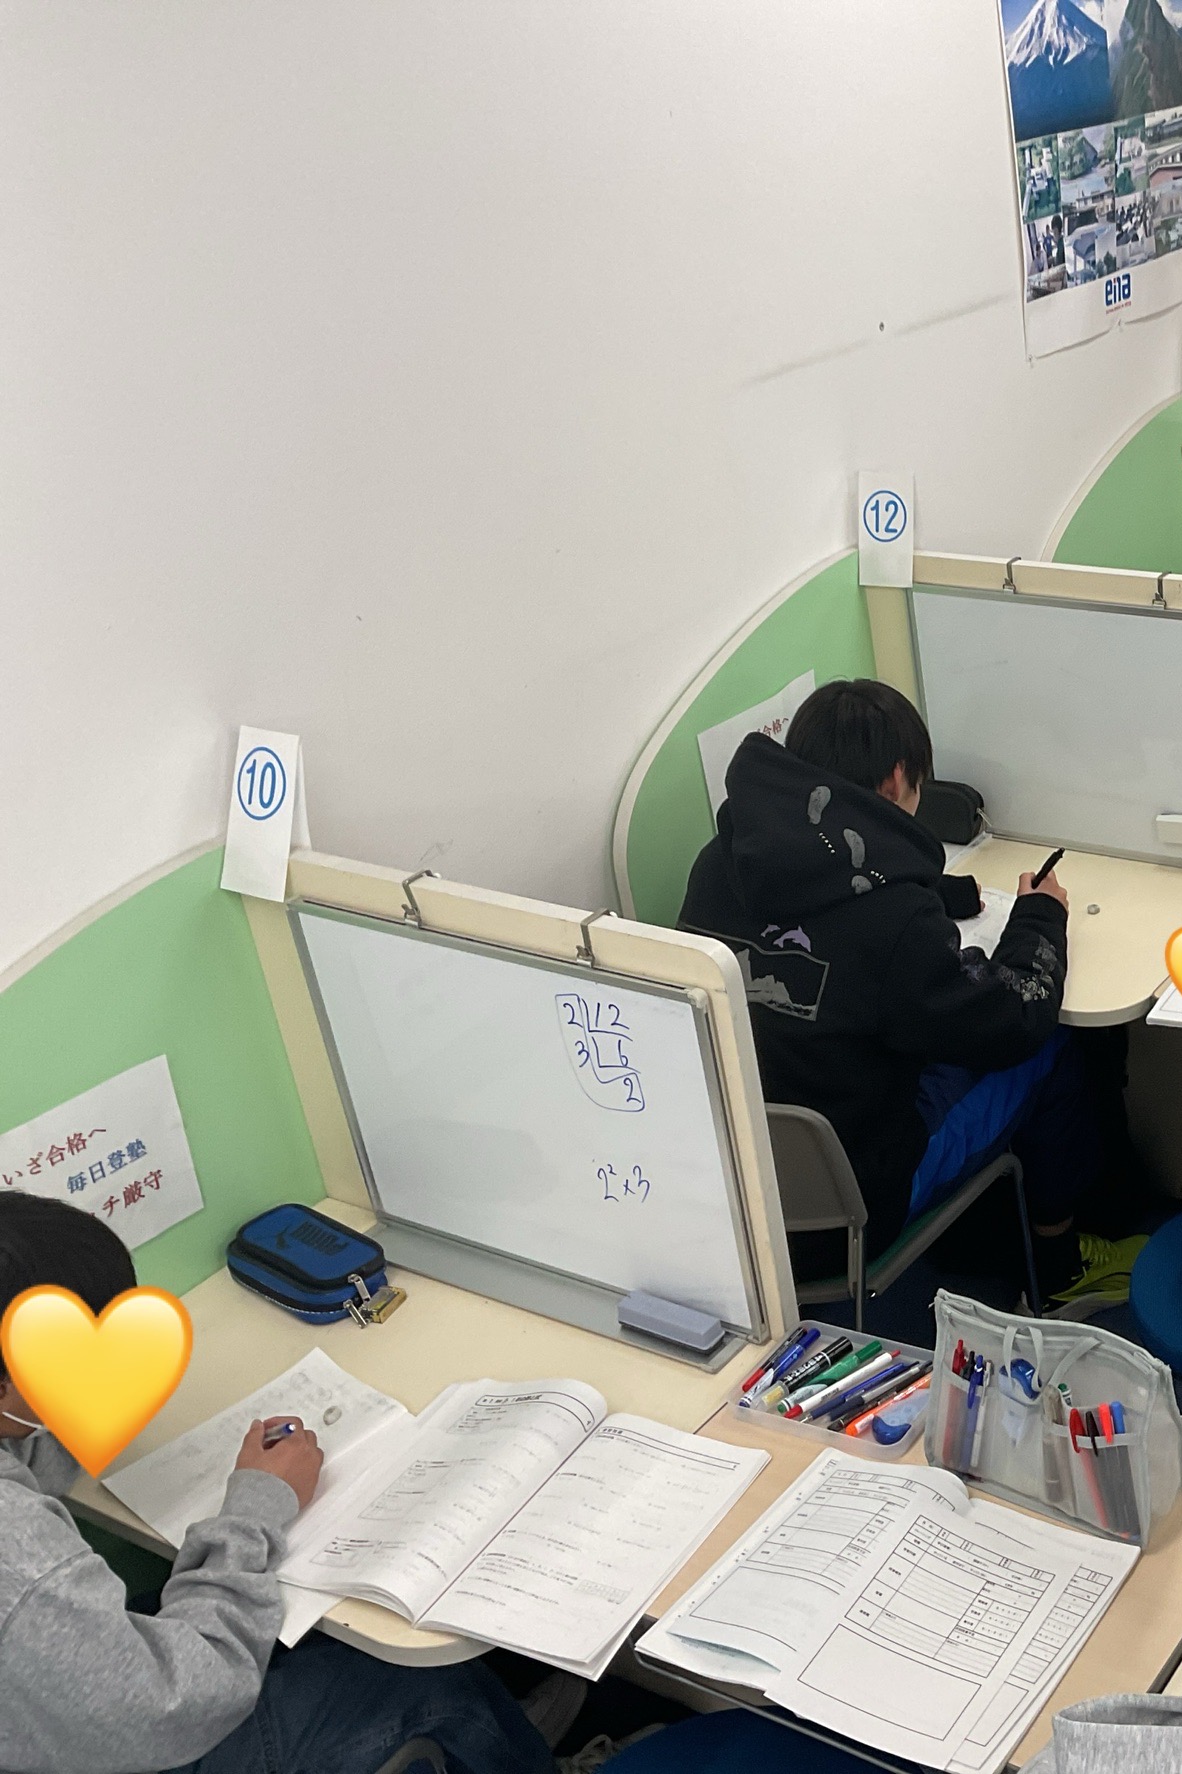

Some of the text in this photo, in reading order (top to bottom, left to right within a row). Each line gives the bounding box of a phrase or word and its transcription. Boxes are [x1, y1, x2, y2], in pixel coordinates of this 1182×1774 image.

[1105, 273, 1131, 306] ena
[870, 499, 899, 533] 12
[756, 717, 790, 738] 合格へ
[246, 759, 277, 809] 10
[2, 1128, 107, 1187] いざ合格へ
[66, 1138, 148, 1195] 毎日登塾
[88, 1169, 163, 1218] チ厳守
